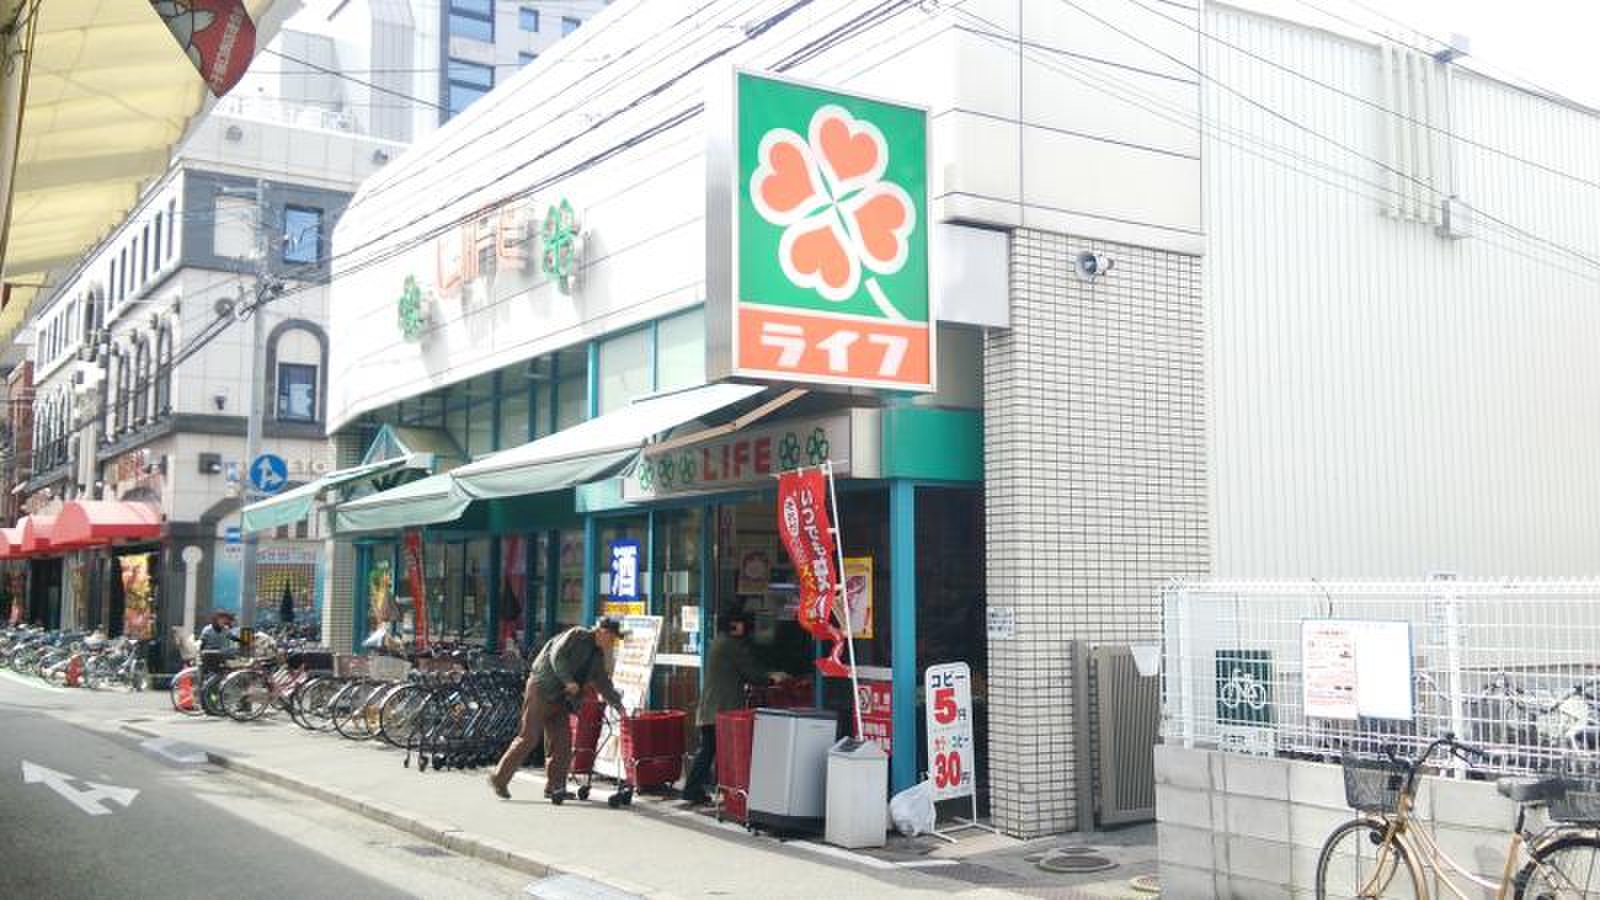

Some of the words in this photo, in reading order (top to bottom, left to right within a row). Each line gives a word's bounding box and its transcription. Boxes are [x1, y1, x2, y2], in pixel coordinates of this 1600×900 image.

[437, 199, 531, 297] LIFE
[760, 320, 909, 377] ライフ
[703, 436, 770, 481] LIFE
[608, 545, 637, 597] 酒
[931, 671, 965, 688] コピー
